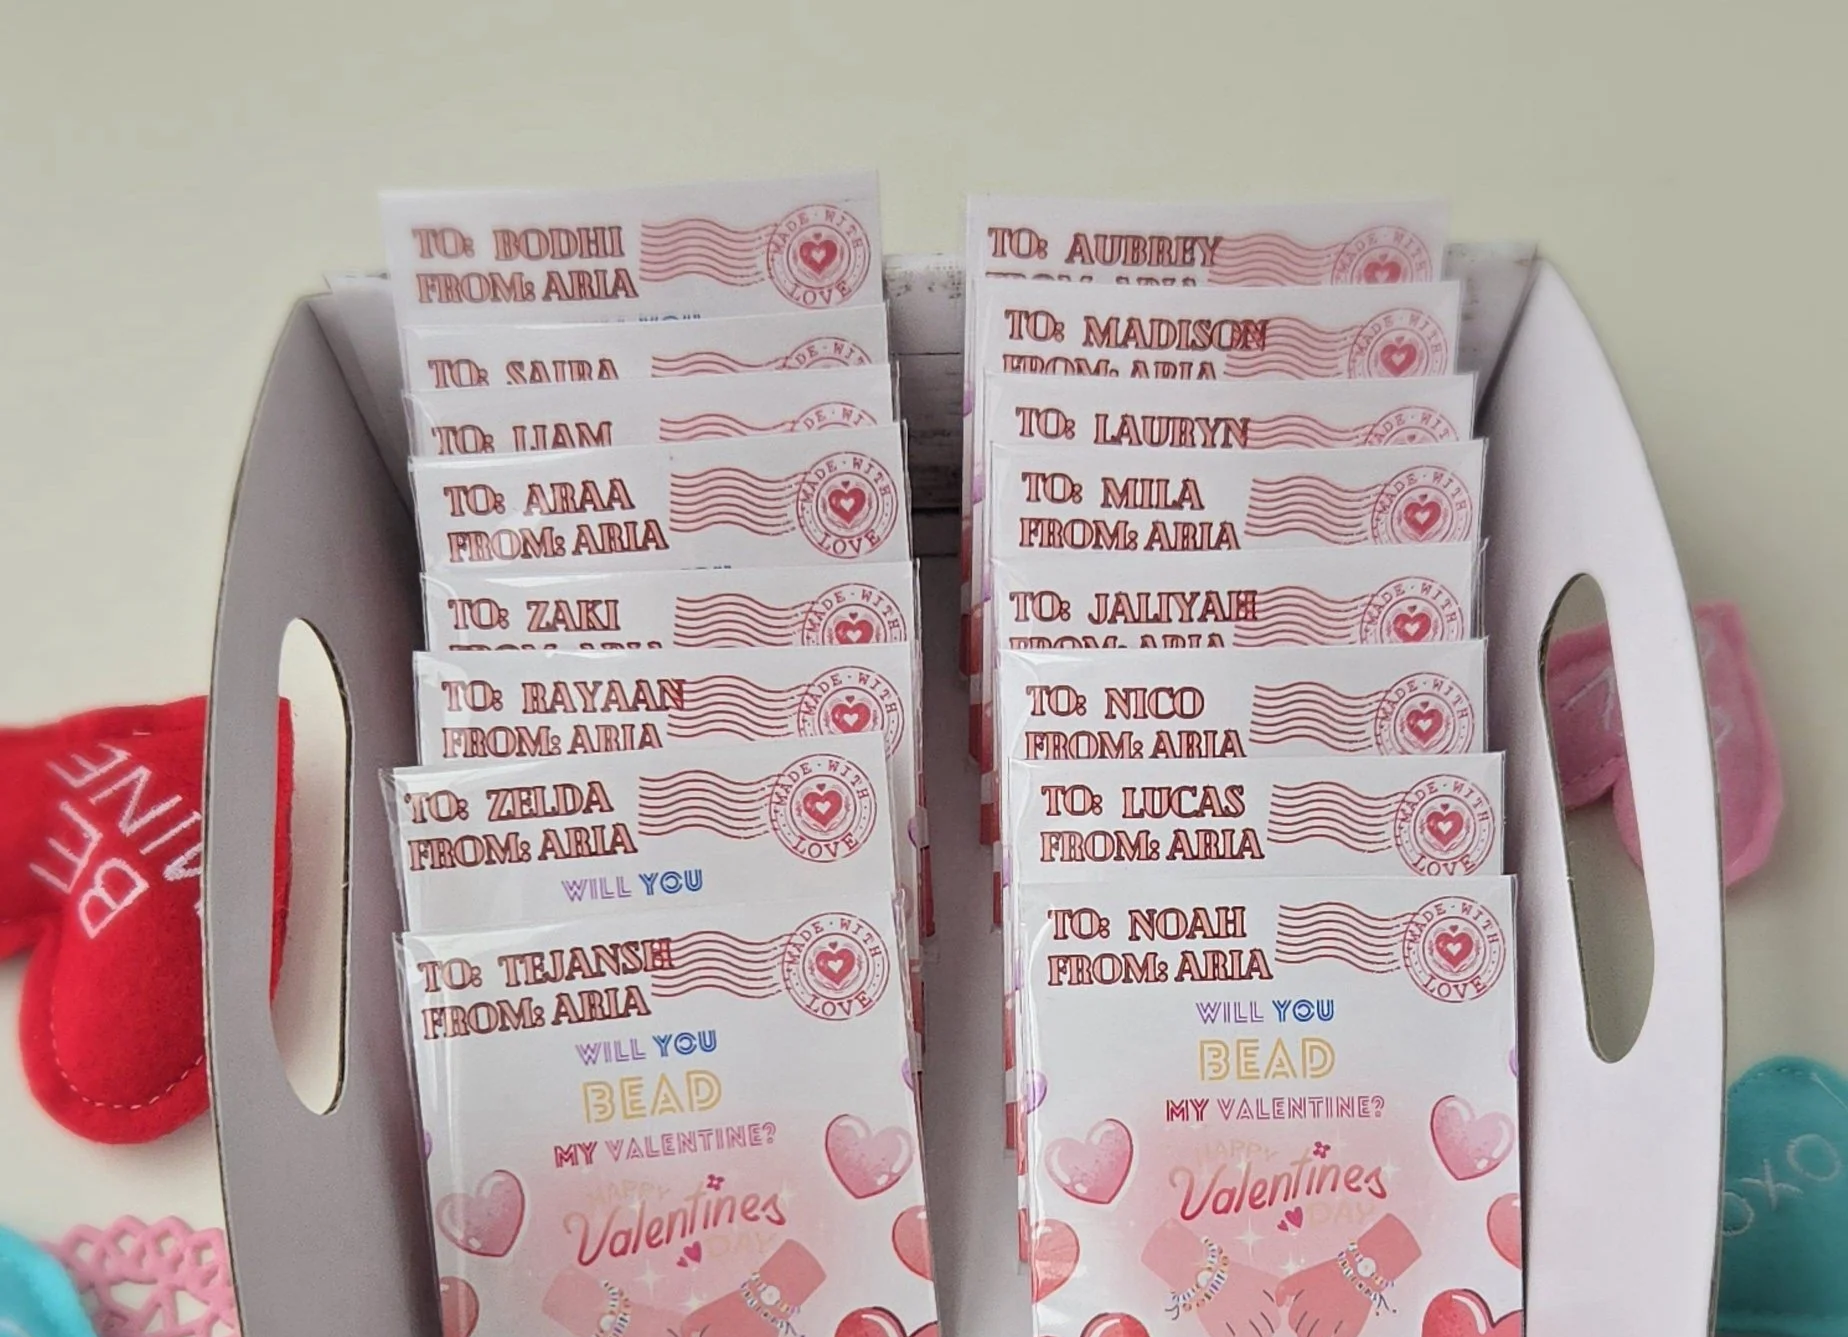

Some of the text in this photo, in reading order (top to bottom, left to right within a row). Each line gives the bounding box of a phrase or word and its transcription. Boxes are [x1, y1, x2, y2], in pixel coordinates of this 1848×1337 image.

[412, 226, 625, 261] TO: BODHI
[825, 209, 863, 249] WITH
[987, 226, 1225, 267] TO: AUBREY
[416, 268, 639, 304] FROM: ARIA
[789, 280, 853, 305] LOVE
[1004, 309, 1269, 351] TO: MADISON
[1409, 312, 1442, 353] WITH
[428, 358, 489, 389] TO:
[432, 424, 495, 455] TO:
[1015, 406, 1252, 448] TO: LAURYN
[853, 457, 891, 497] WITH
[1022, 471, 1204, 510] TO: MILA
[1433, 471, 1466, 511] WITH
[443, 477, 635, 517] TO: ARAA
[447, 519, 670, 564] FROM: ARIA
[819, 529, 882, 555] LOVE
[1019, 517, 1241, 552] FROM: ARIA
[447, 598, 620, 632] TO: ZAKI
[860, 588, 900, 630] WITH
[1009, 590, 1258, 624] TO: JALIYAH
[1420, 582, 1458, 623] WITH
[441, 678, 687, 714] TO: RAYAAN
[857, 671, 898, 714] WITH
[1026, 684, 1205, 720] TO: NICO
[1432, 678, 1468, 719] WITH
[442, 723, 663, 760] FROM: ARIA
[1025, 729, 1247, 760] FROM: ARIA
[828, 759, 869, 800] WITH
[404, 781, 615, 824] TO: ZELDA
[1041, 784, 1245, 819] TO: LUCAS
[1452, 779, 1491, 822] WITH
[408, 822, 638, 872] FROM: ARIA
[792, 832, 859, 859] LOVE
[1040, 828, 1265, 862] FROM: ARIA
[1412, 853, 1476, 876] LOVE
[561, 868, 703, 902] WILL YOU
[840, 918, 882, 958] WITH
[1048, 906, 1247, 942] TO: NOAH
[1461, 902, 1500, 944] WITH
[417, 937, 674, 994] TO: TEJANSH
[1047, 948, 1273, 987] FROM: ARIA
[806, 990, 873, 1016] LOVE
[1422, 975, 1487, 1000] LOVE
[421, 985, 652, 1040] FROM: ARIA
[1195, 998, 1334, 1024] WILL YOU
[575, 1029, 718, 1065] WILL YOU
[1199, 1036, 1336, 1081] BEAD
[581, 1069, 723, 1124] BEAD
[1165, 1095, 1386, 1122] MY VALENTINE?
[554, 1122, 777, 1168] MY VALENTINE?
[1168, 1145, 1388, 1220] Valentines
[562, 1180, 787, 1267] Valentines
